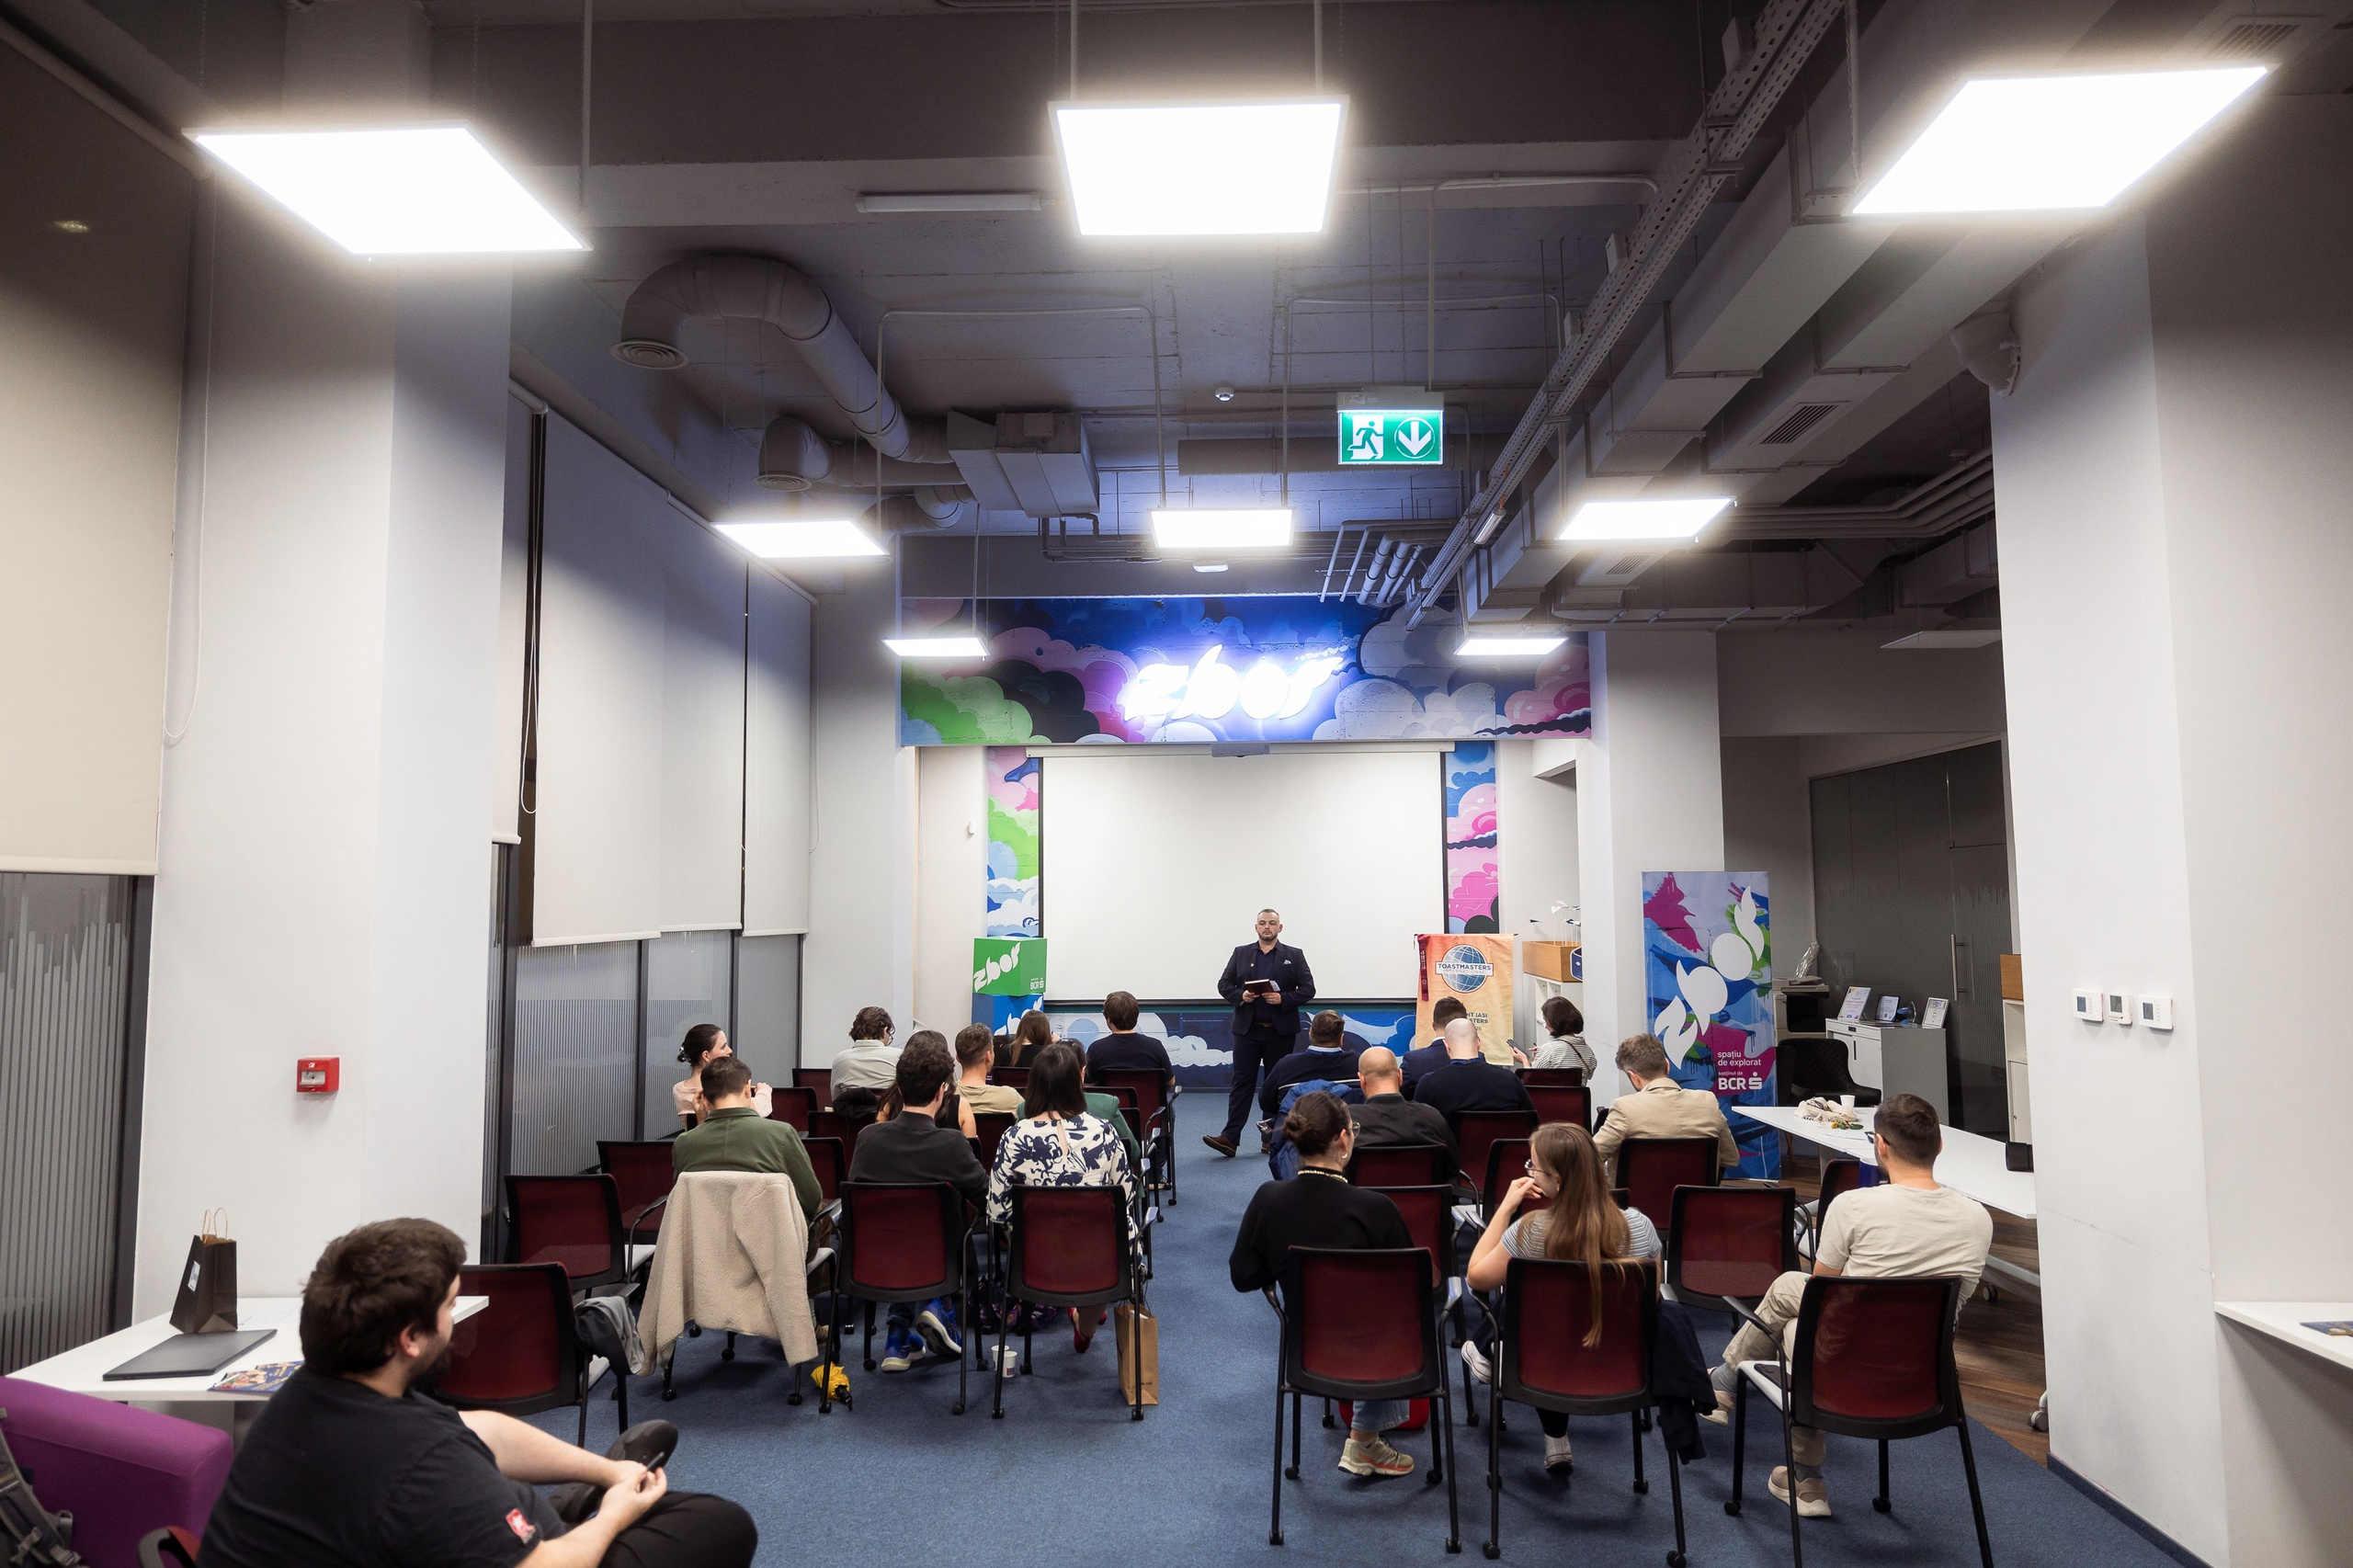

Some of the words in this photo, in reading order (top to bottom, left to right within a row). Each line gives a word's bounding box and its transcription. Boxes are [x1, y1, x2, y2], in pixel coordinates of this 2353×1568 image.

[1438, 962, 1492, 971] TOASTMASTERS
[1030, 981, 1040, 990] BCR
[1717, 1050, 1742, 1060] spațiu
[1729, 1059, 1762, 1068] explorat
[1718, 1077, 1747, 1090] BCR
